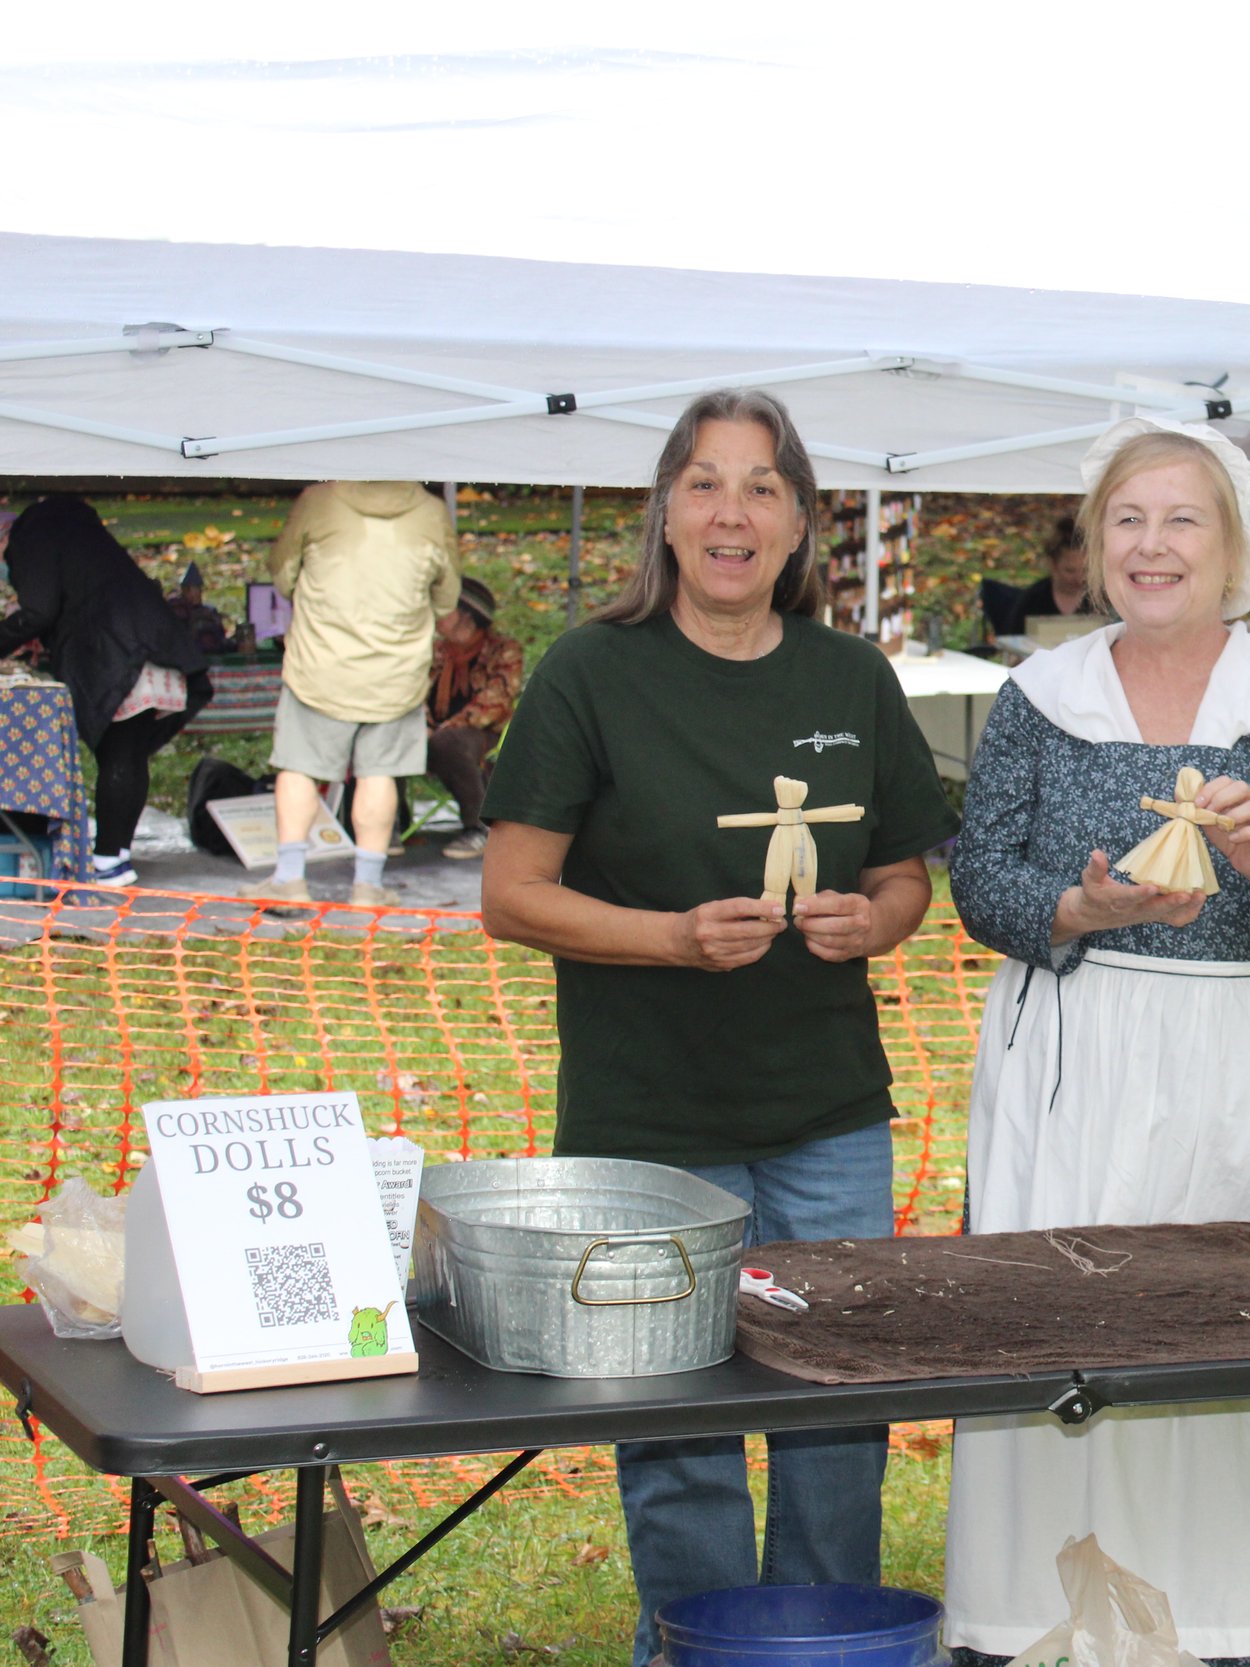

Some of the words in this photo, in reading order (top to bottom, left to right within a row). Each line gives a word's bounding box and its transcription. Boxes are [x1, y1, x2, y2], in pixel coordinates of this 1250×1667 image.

[156, 1103, 356, 1138] CORNSHUCK
[189, 1136, 335, 1175] DOLLS
[246, 1181, 304, 1225] $8
